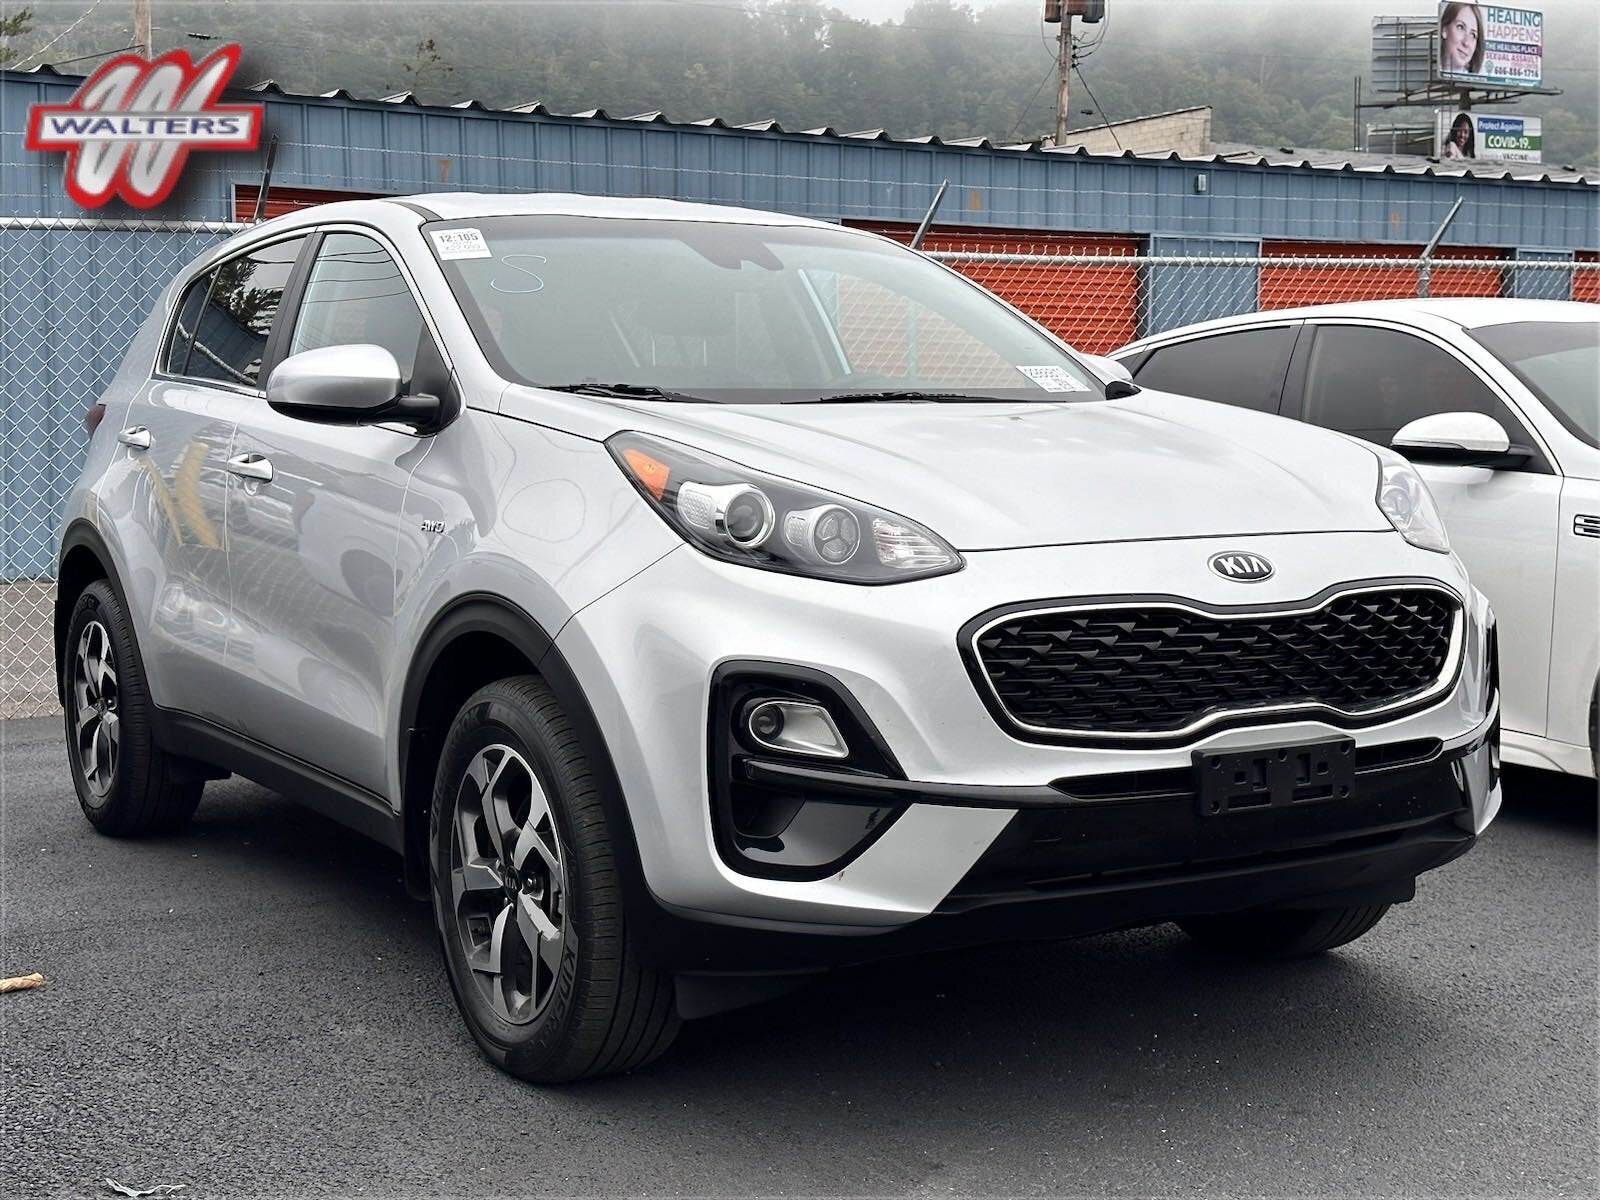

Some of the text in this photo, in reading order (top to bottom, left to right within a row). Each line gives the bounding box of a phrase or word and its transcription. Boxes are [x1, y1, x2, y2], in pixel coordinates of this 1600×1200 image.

[1487, 7, 1540, 27] HEALING
[1487, 24, 1540, 43] HAPPENS
[1479, 120, 1523, 133] Protect Against
[1503, 153, 1528, 161] VACCINE
[1218, 555, 1270, 575] KIA
